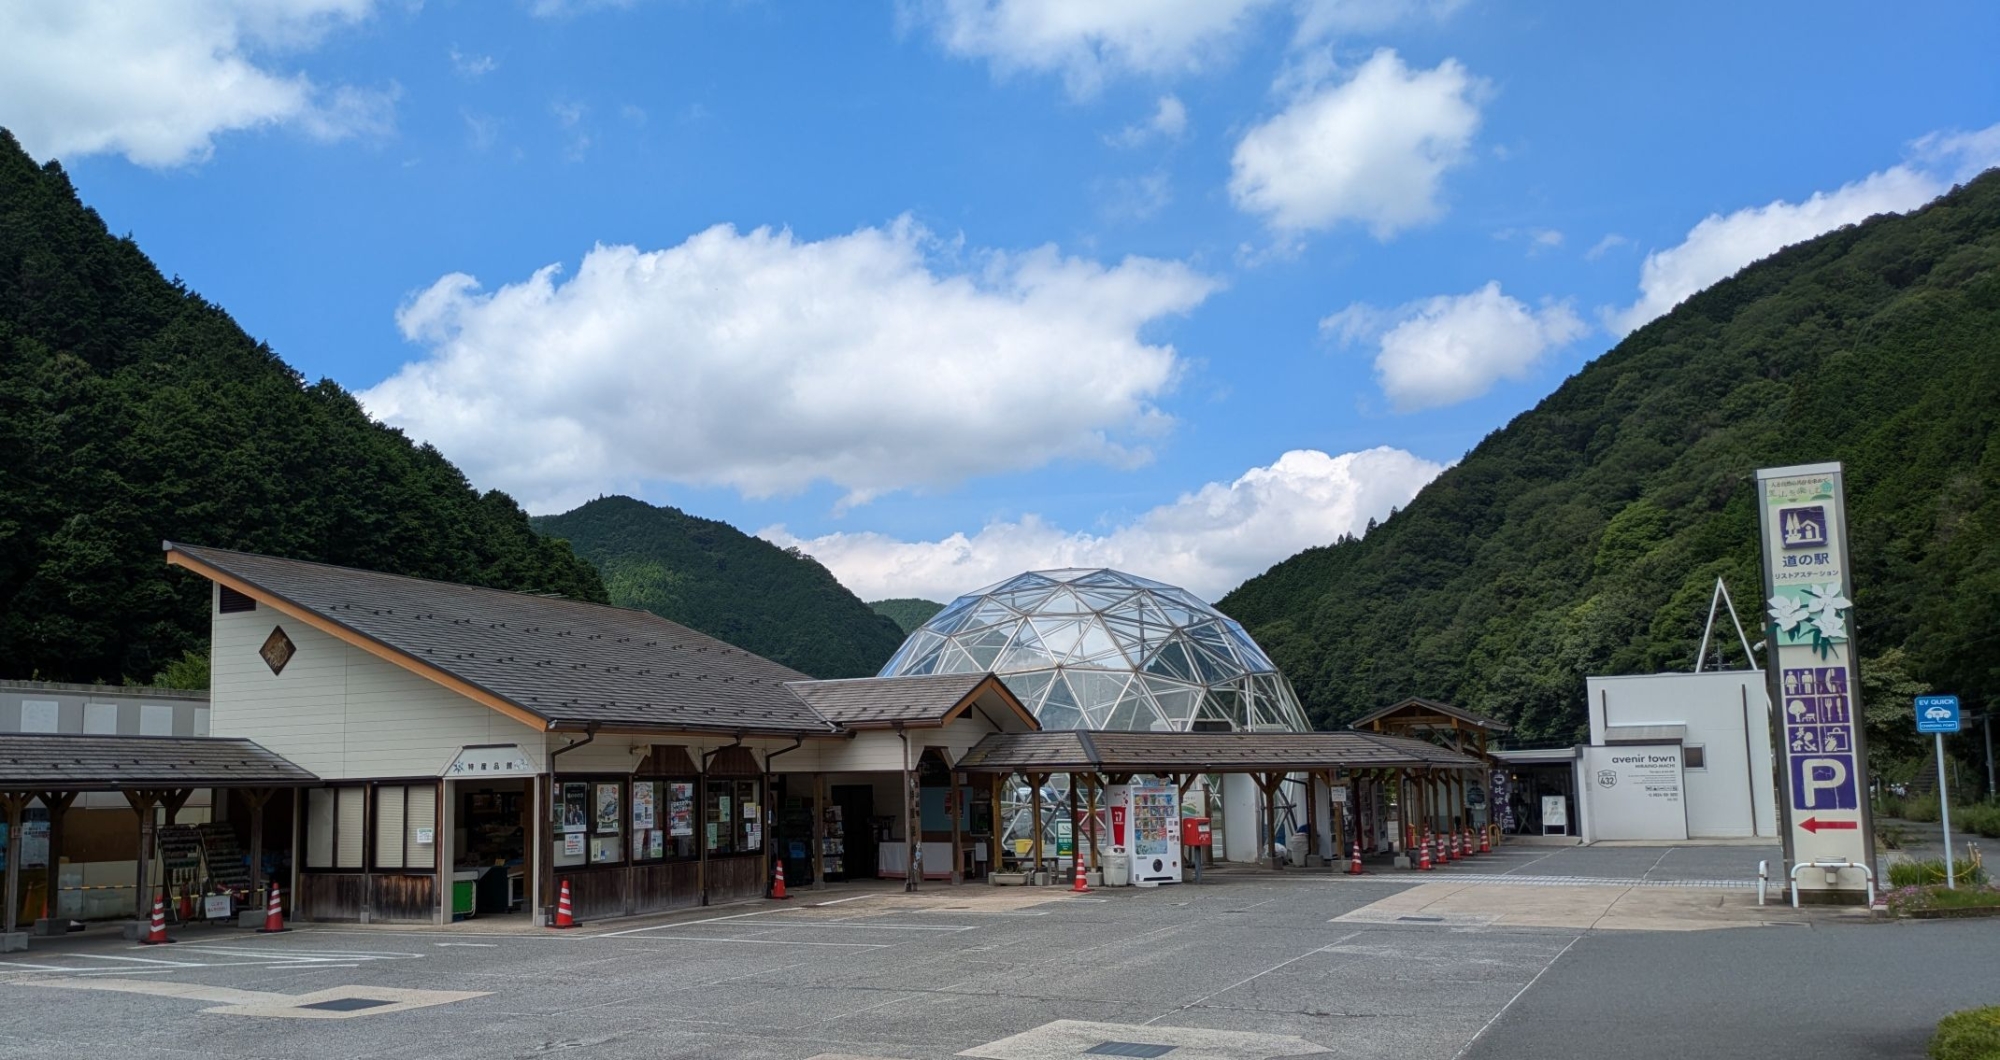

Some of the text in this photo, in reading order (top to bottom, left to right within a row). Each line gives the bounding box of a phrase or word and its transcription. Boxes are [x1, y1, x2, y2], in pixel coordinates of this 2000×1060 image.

[1782, 553, 1829, 568] 道の駅
[1775, 570, 1839, 580] リストアステーション
[1612, 754, 1676, 763] avenir town
[1600, 776, 1614, 785] 432
[1802, 758, 1846, 808] P
